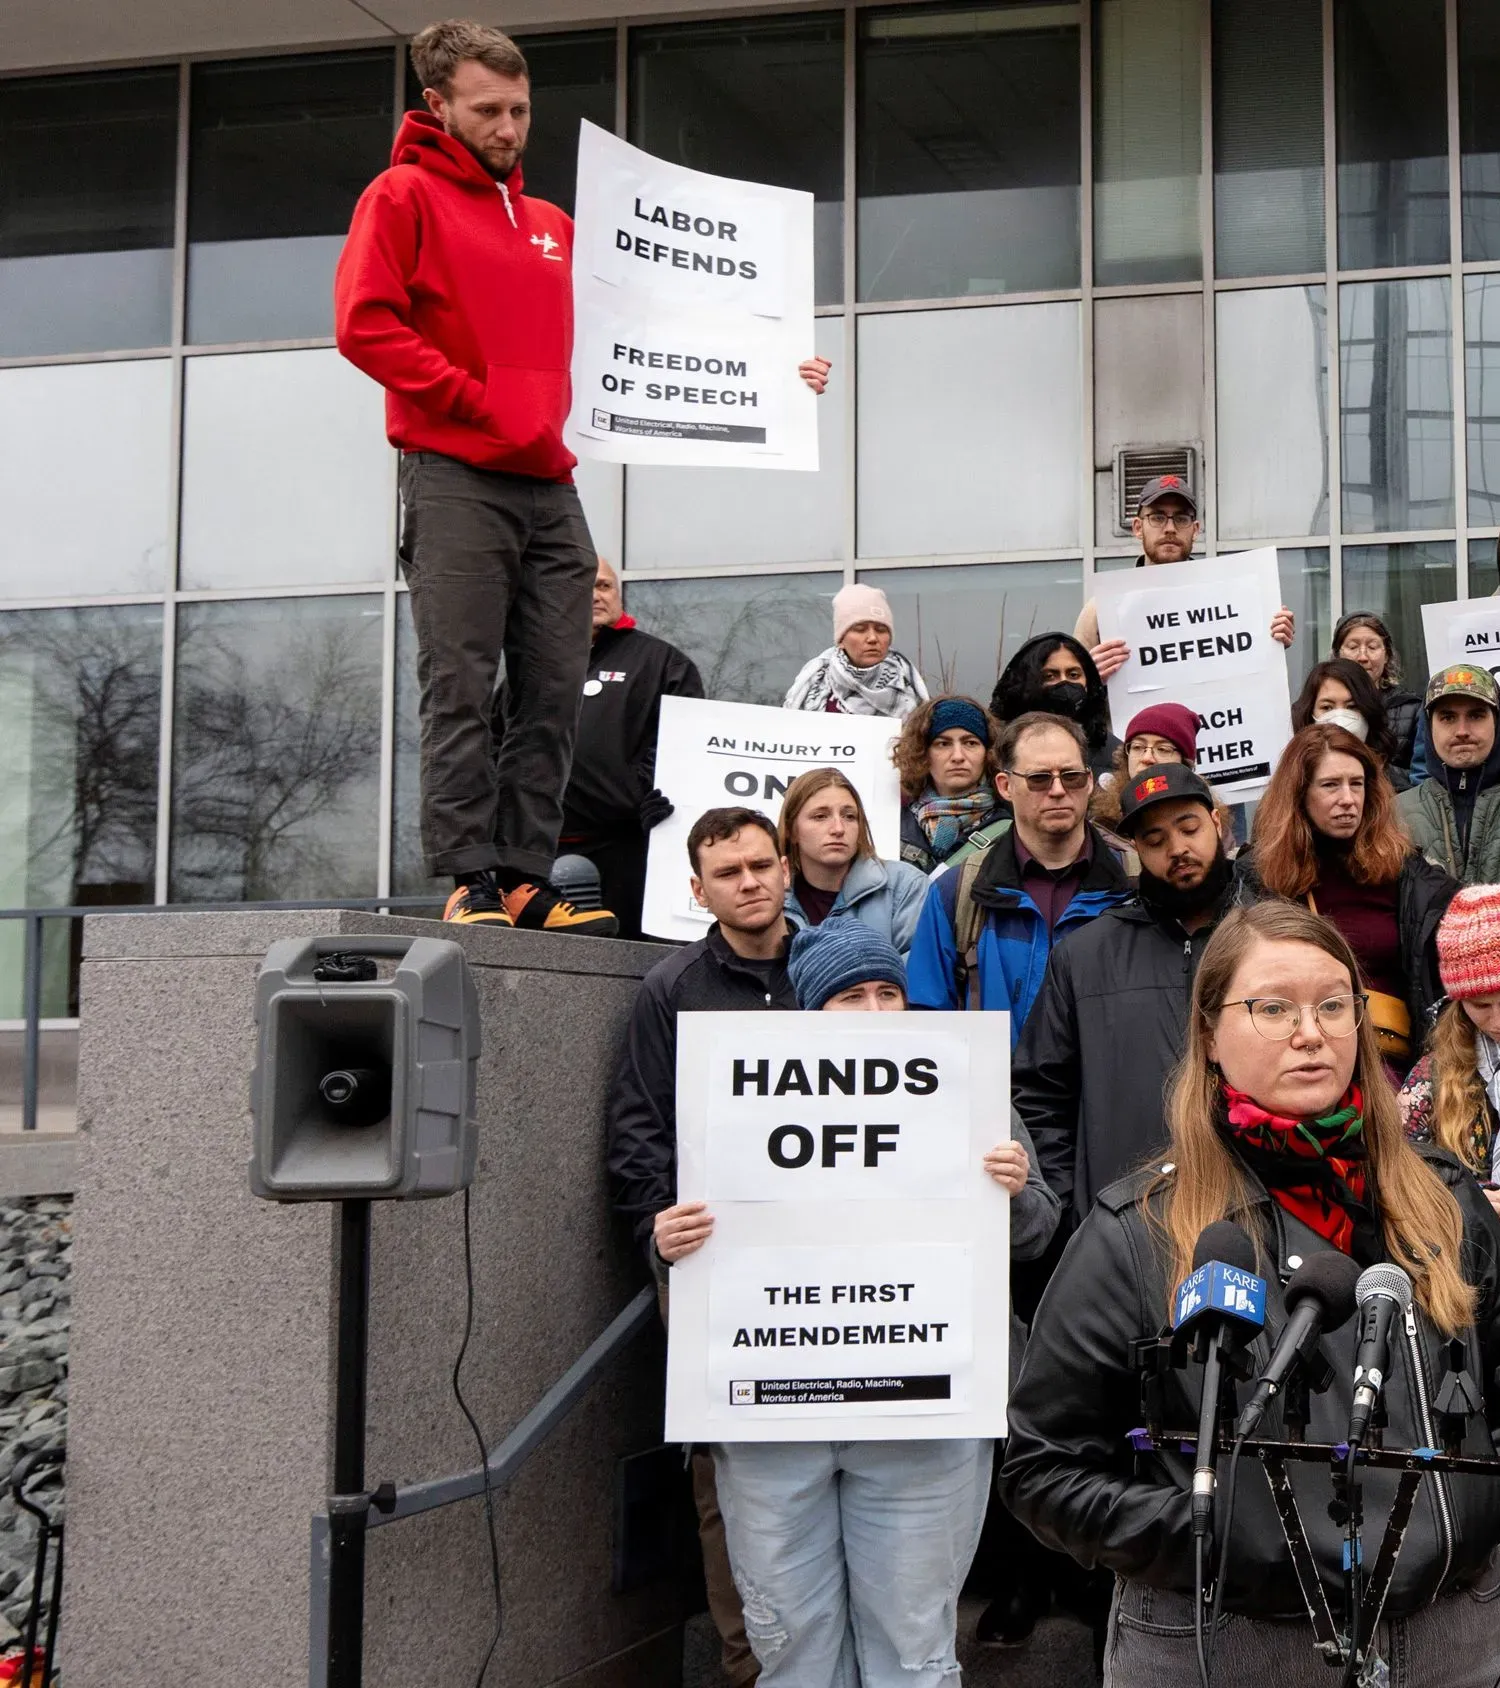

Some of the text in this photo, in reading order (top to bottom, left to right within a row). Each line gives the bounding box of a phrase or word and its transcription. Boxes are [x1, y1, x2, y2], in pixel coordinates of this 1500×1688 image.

[634, 197, 738, 242] LABOR
[615, 229, 757, 280] DEFENDS
[613, 343, 747, 377] FREEDOM
[601, 374, 758, 407] OF SPEECH
[652, 430, 683, 438] America
[1146, 604, 1239, 630] WE WILL
[1139, 631, 1253, 667] DEFEND
[1465, 633, 1489, 646] AN
[1199, 707, 1243, 730] ACH
[707, 736, 855, 757] AN INJURY TO
[1195, 740, 1254, 765] THER
[724, 771, 796, 800] ON
[1136, 775, 1168, 800] UE
[732, 1057, 939, 1096] HANDS
[767, 1124, 900, 1169] OFF
[1181, 1270, 1205, 1297] KARE
[1223, 1268, 1259, 1292] KARE
[764, 1283, 915, 1305] THE FIRST
[1224, 1285, 1247, 1310] 11
[732, 1323, 949, 1348] AMENDEMENT
[760, 1392, 844, 1402] Workers of America
[761, 1379, 904, 1390] United Electrical, Radio, Machine,
